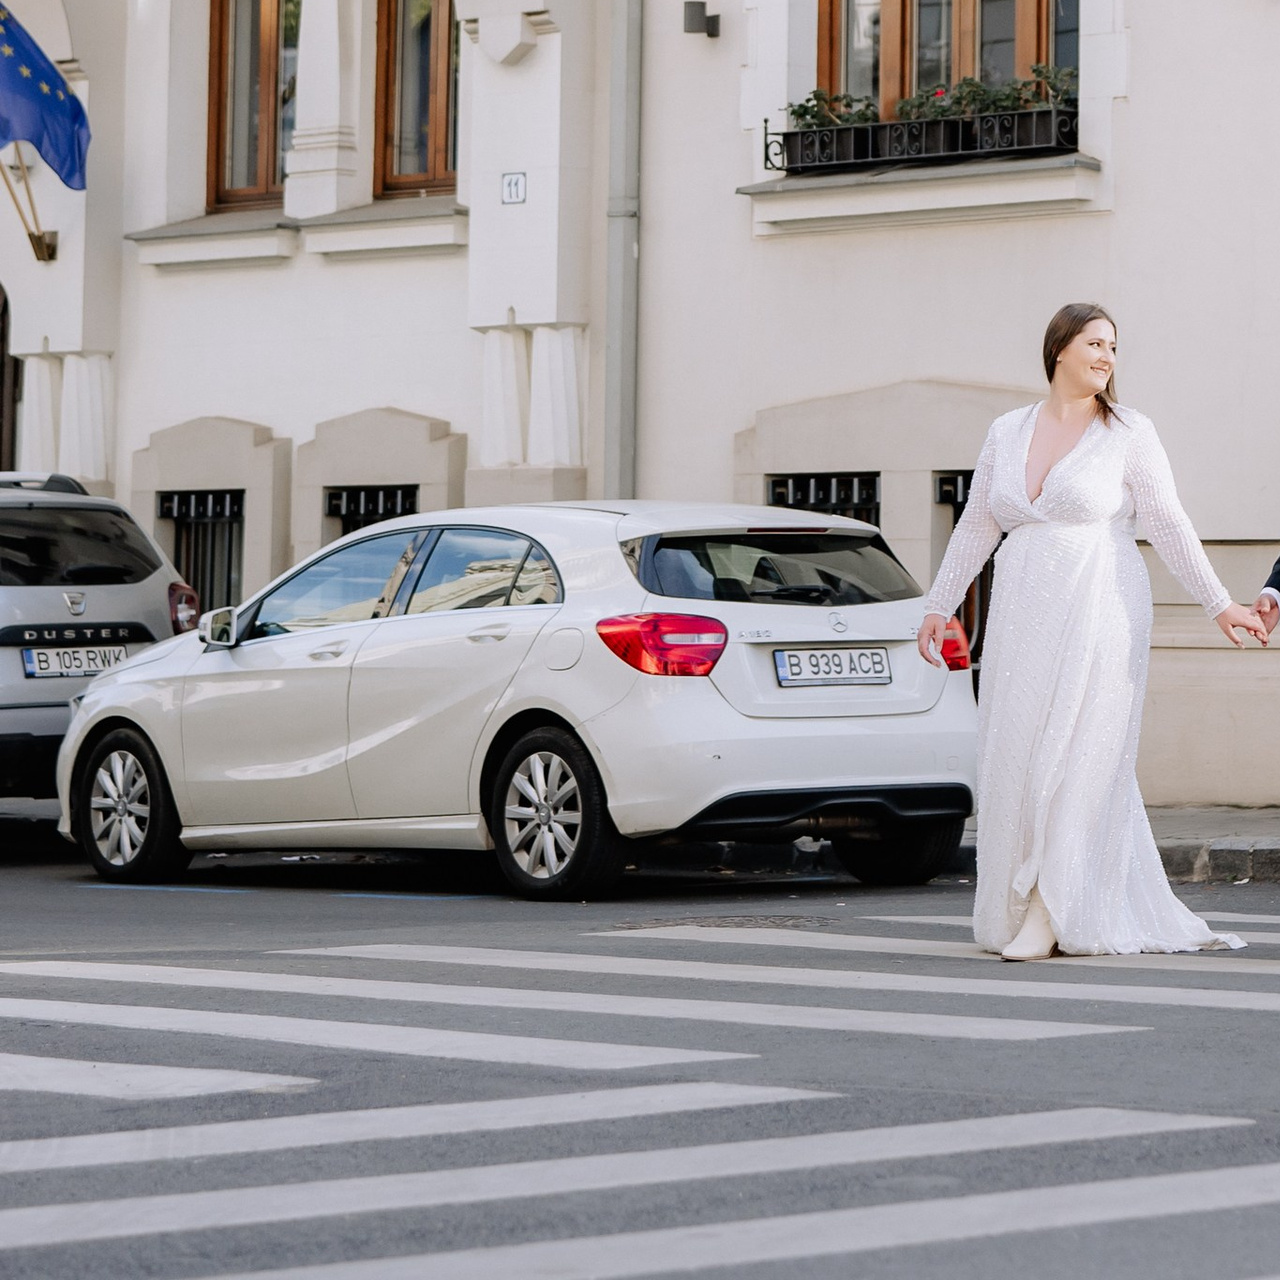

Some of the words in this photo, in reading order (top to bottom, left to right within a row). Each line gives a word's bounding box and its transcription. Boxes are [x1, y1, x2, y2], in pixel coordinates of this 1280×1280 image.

[507, 177, 519, 200] 11
[24, 628, 129, 640] DUSTER
[37, 652, 50, 671] B
[56, 650, 83, 670] 105
[86, 649, 123, 669] RWK
[787, 654, 802, 676] B
[808, 653, 843, 676] 939
[849, 652, 885, 675] ACB
